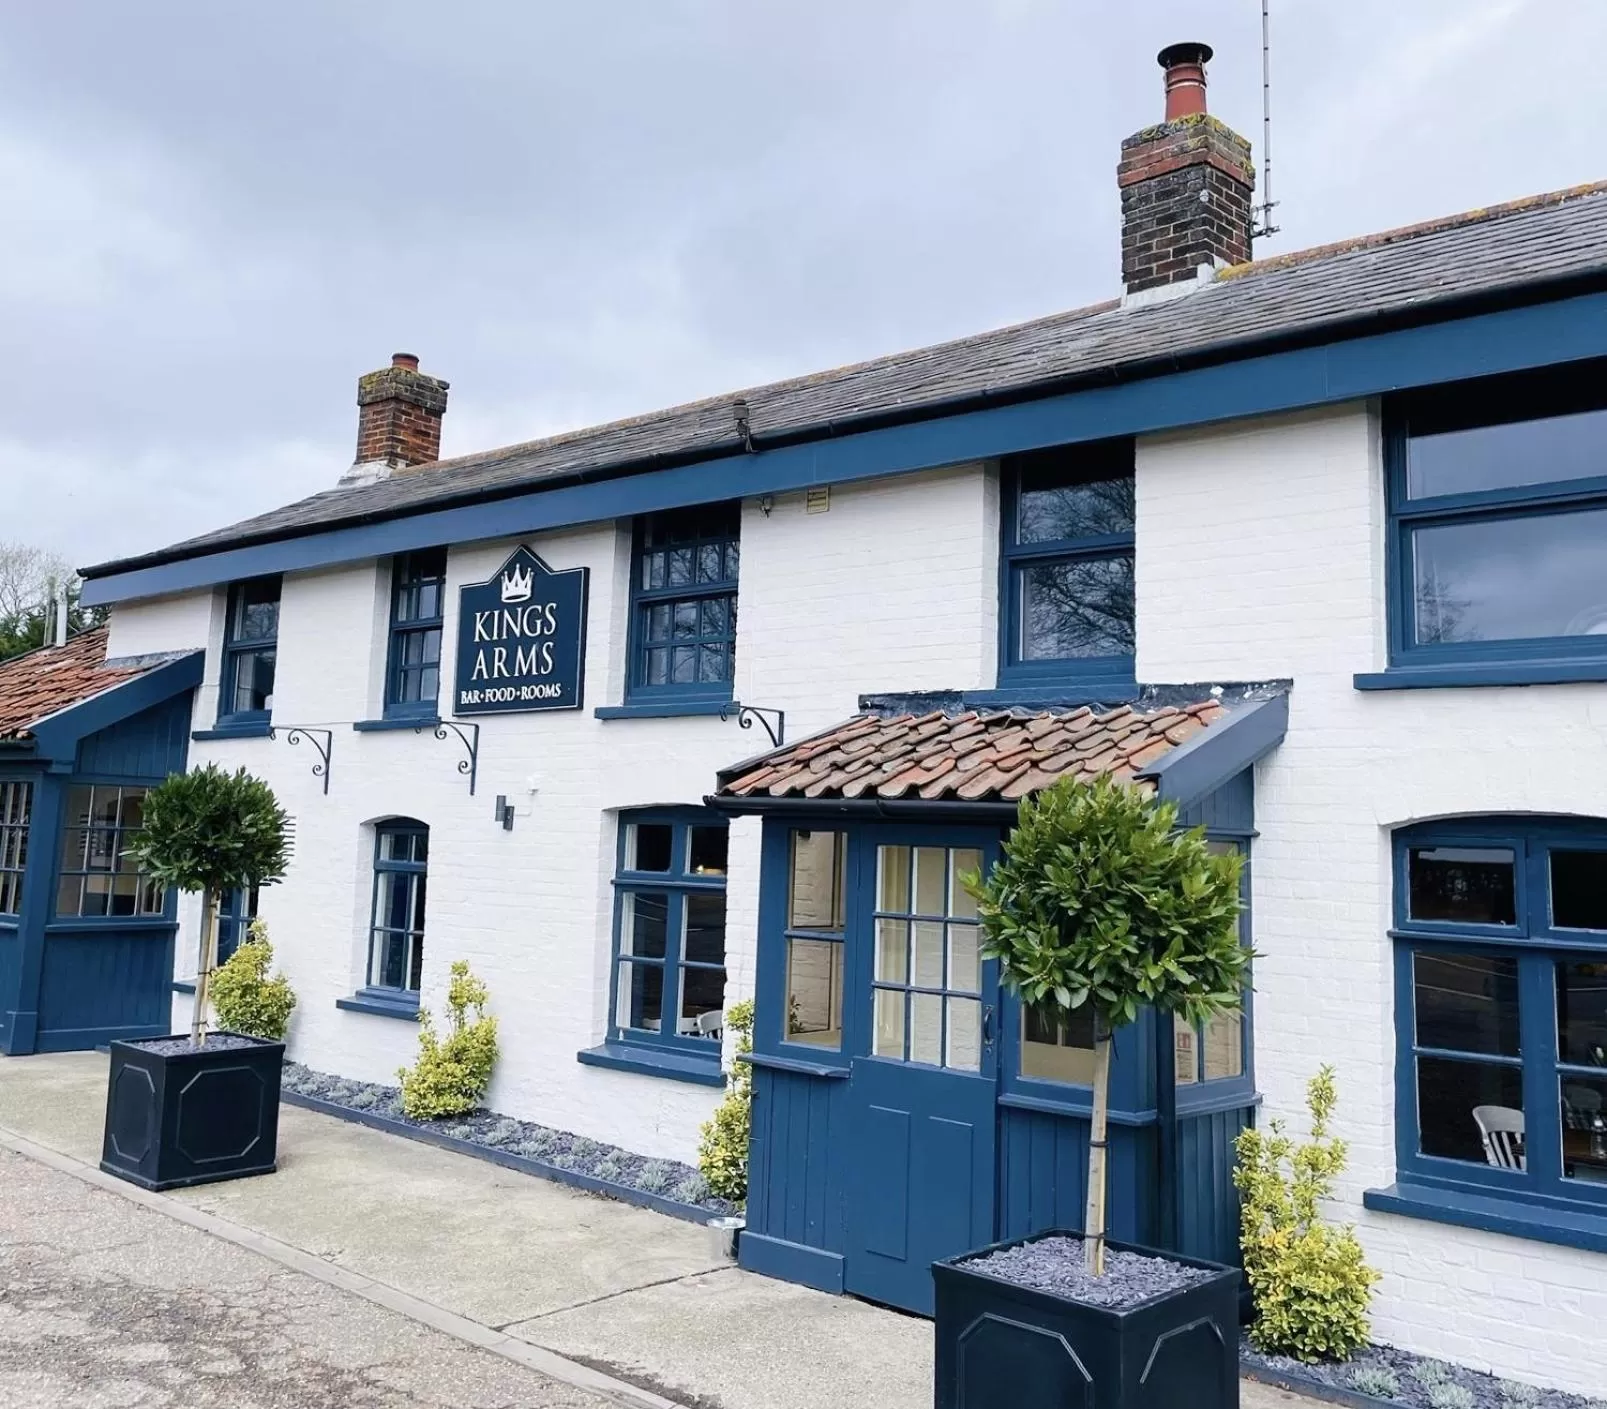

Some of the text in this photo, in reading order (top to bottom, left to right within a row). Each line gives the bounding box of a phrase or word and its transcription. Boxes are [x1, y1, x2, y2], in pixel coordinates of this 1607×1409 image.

[474, 602, 557, 642] KINGS
[470, 641, 555, 681] ARMS
[460, 683, 561, 704] BAR FOOD ROOMS
